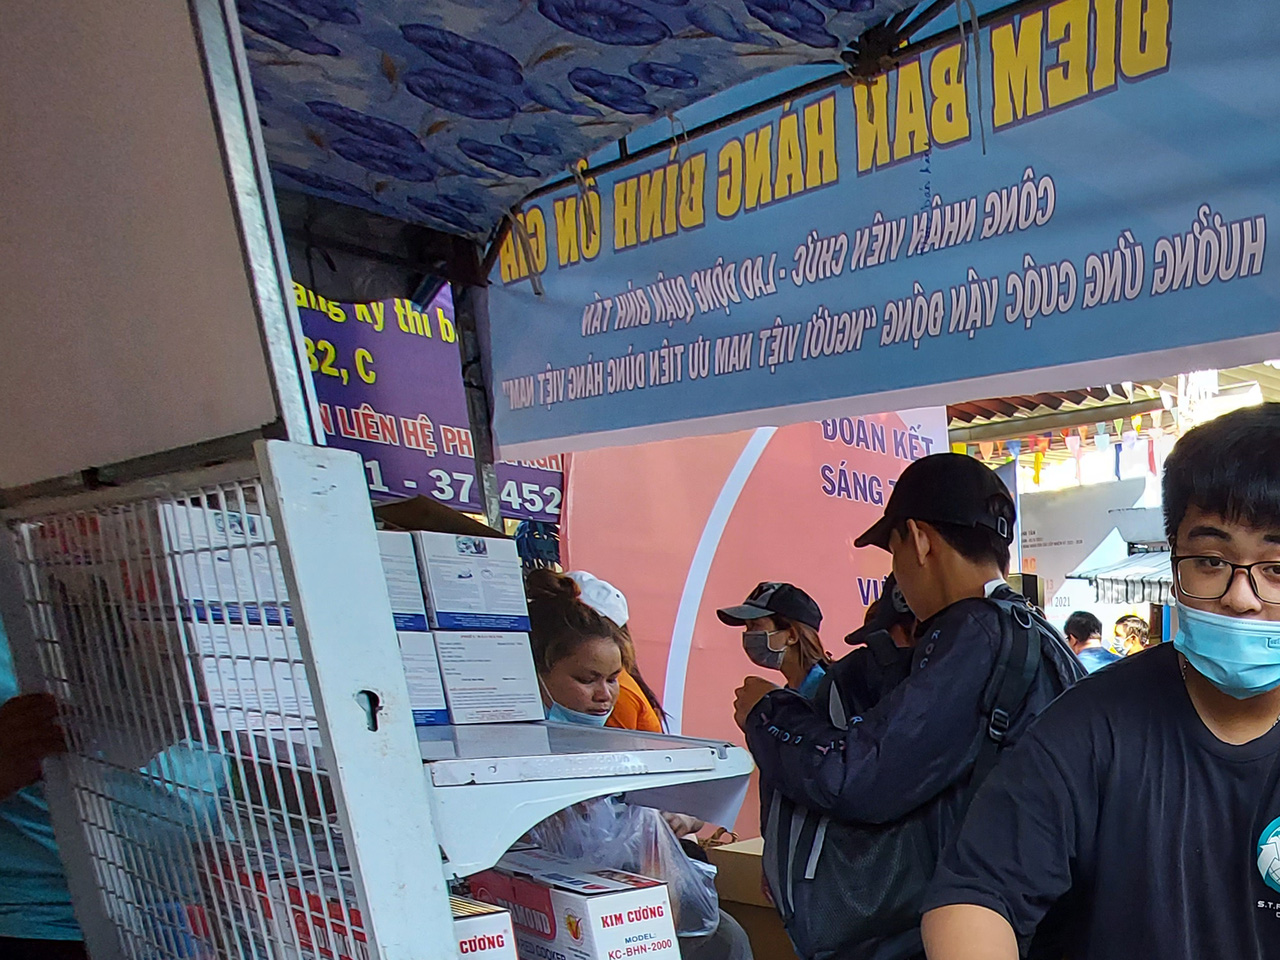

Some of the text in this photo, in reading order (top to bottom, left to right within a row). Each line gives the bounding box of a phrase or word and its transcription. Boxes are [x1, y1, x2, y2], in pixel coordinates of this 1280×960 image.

[336, 402, 400, 448] LIÊN
[399, 412, 437, 459] HỆ
[892, 423, 935, 463] KẾT
[499, 479, 563, 515] 452
[819, 459, 884, 507] SÁNG
[600, 904, 665, 929] KIM CƯƠNG
[458, 933, 506, 955] CƯƠNG
[607, 938, 673, 960] KC-BHN-2000
[624, 931, 657, 945] MODEL:
